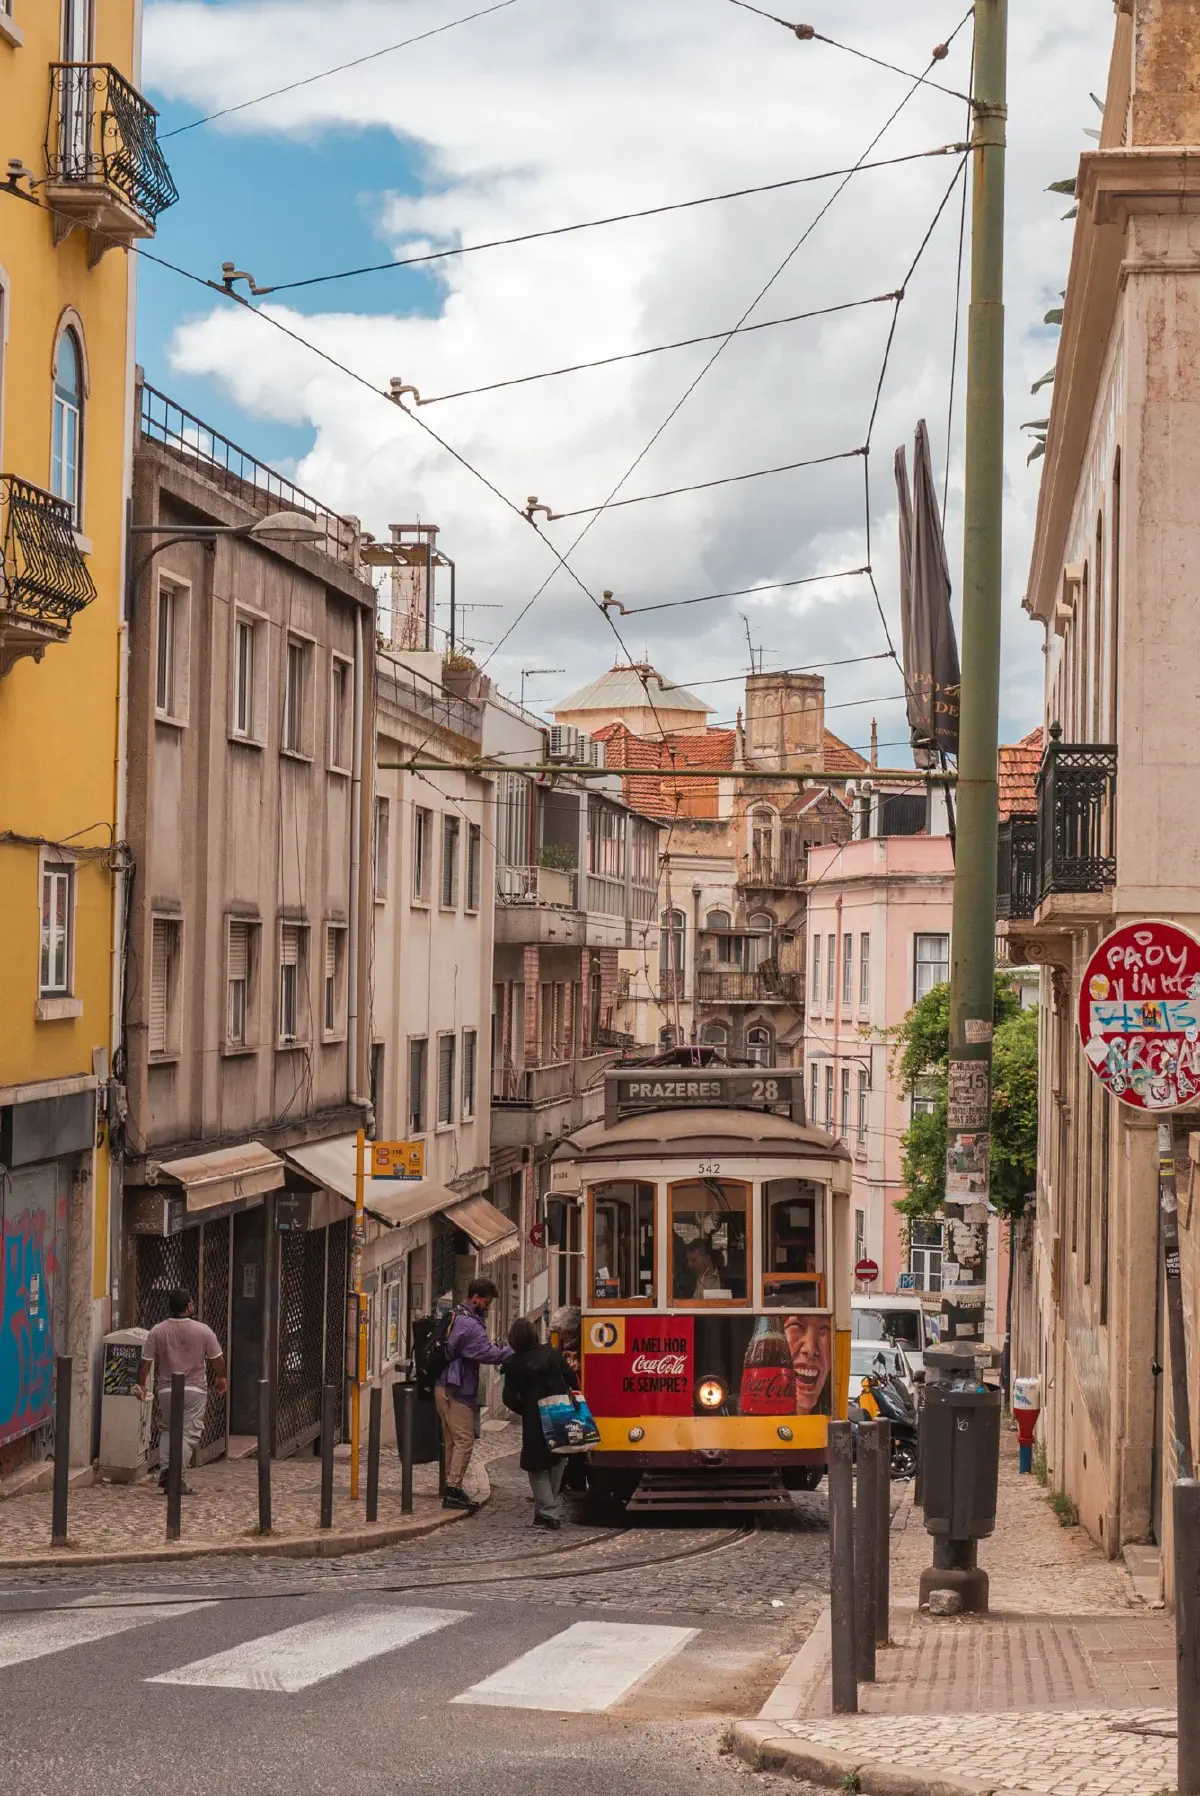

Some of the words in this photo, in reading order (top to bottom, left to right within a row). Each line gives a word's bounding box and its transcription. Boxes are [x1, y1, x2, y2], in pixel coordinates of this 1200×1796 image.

[966, 1074, 984, 1089] 15
[629, 1082, 721, 1099] PRAZERES
[751, 1079, 779, 1101] 28
[698, 1163, 721, 1175] 542
[640, 1337, 688, 1353] MELHOR
[631, 1354, 688, 1375] Coca-Cola
[622, 1377, 637, 1393] DE
[637, 1377, 688, 1393] SEMPRE?
